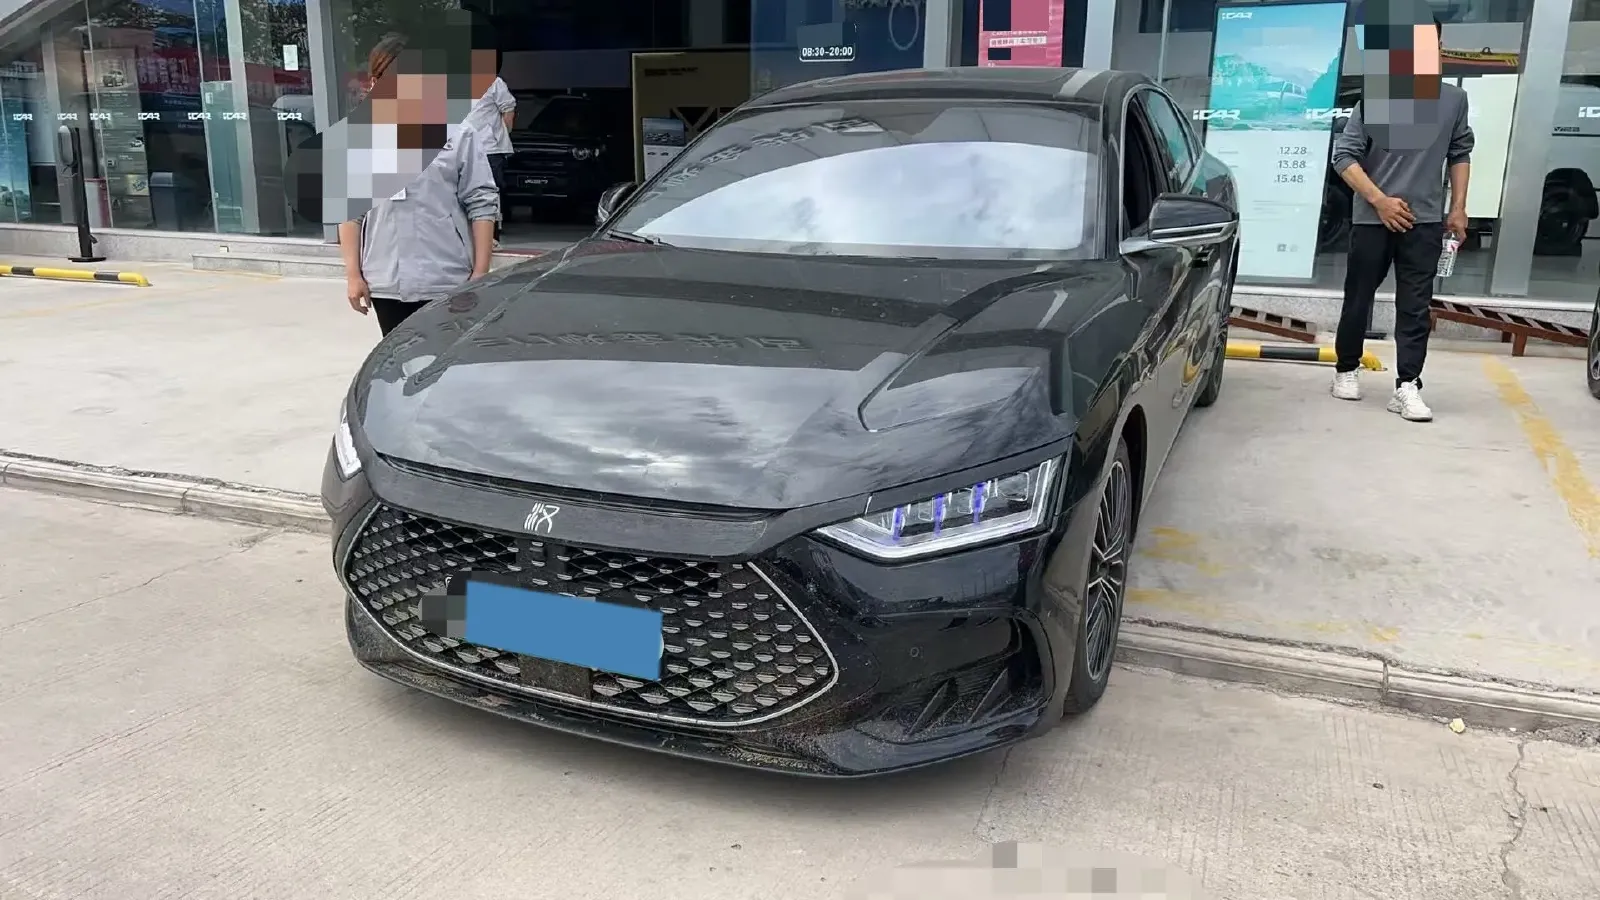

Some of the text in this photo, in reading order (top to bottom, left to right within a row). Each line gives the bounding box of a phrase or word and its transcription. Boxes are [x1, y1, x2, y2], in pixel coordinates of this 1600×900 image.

[802, 46, 853, 57] 08:30-20:00
[1280, 146, 1307, 155] 12.28
[1278, 160, 1307, 169] 13.88
